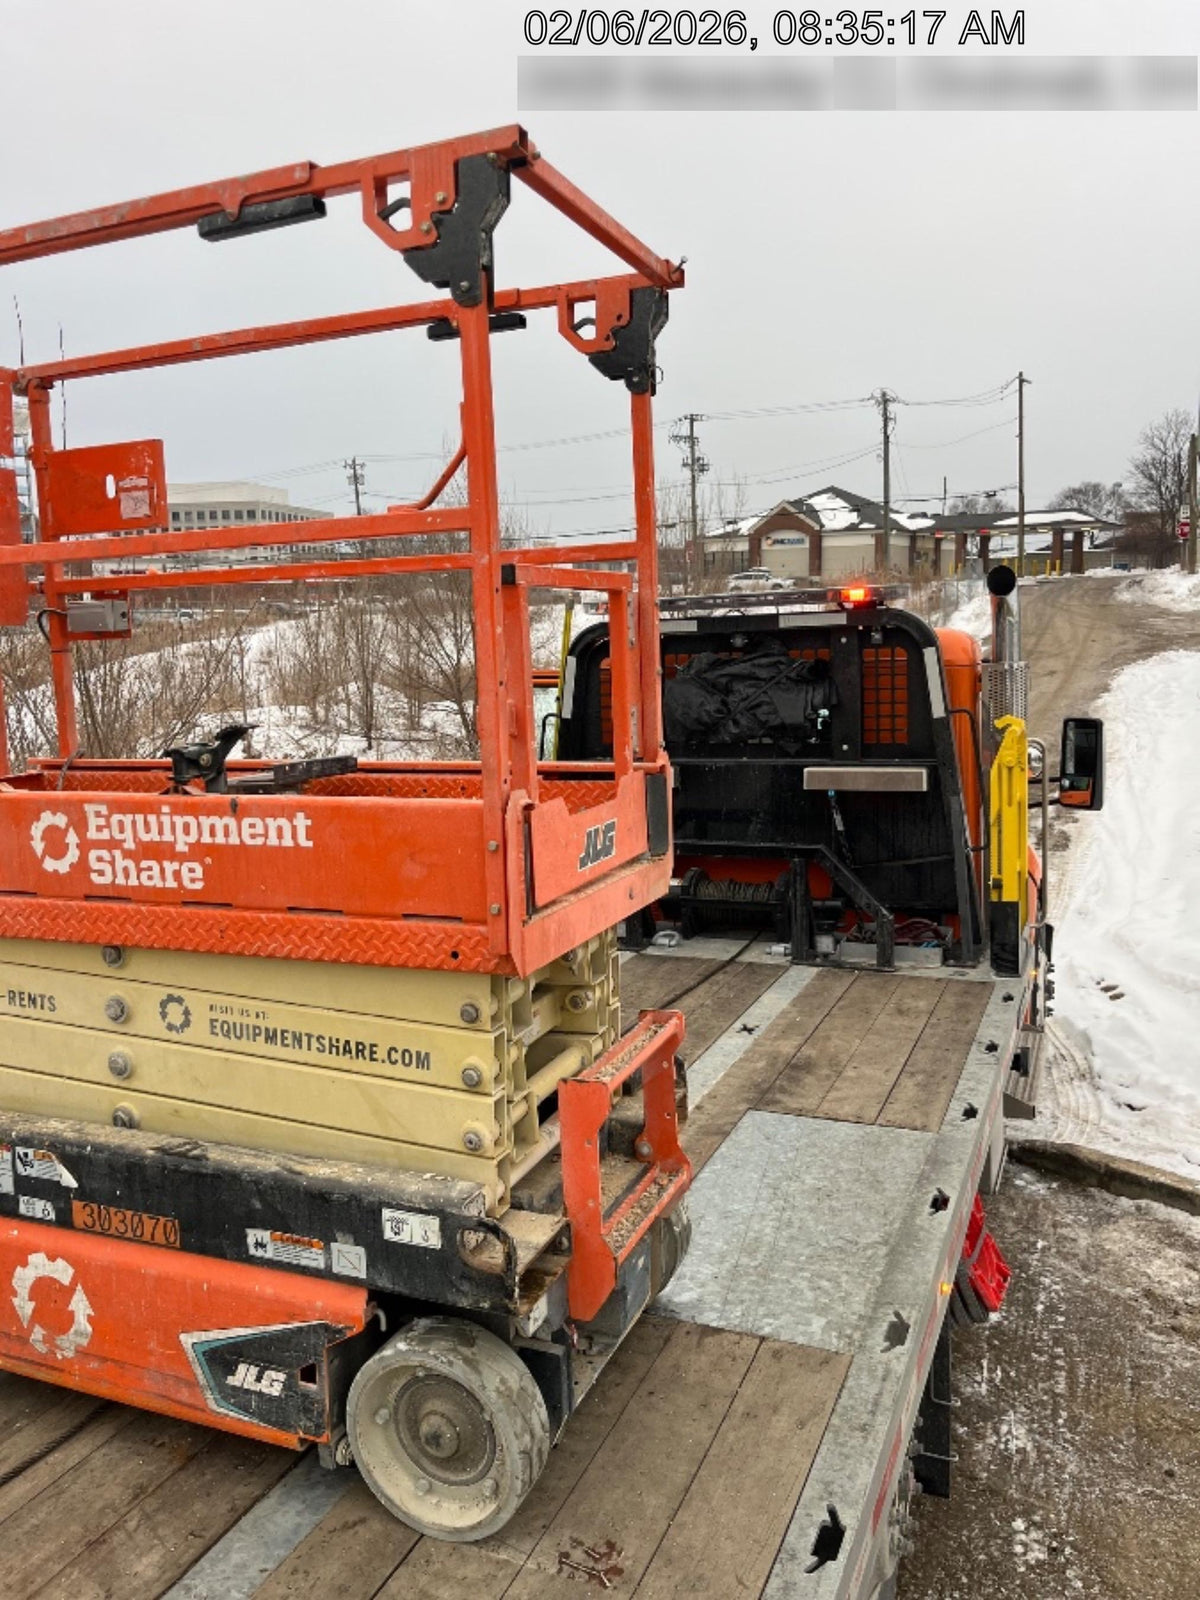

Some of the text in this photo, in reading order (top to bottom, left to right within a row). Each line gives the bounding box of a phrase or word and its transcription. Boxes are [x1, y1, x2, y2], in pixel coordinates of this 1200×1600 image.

[84, 802, 314, 853] Equipment
[577, 818, 618, 872] JLG
[87, 848, 205, 890] Share
[208, 1017, 432, 1072] EQUIPMENTSHARE.COM
[82, 1202, 178, 1246] 303070
[225, 1362, 288, 1397] JLG
